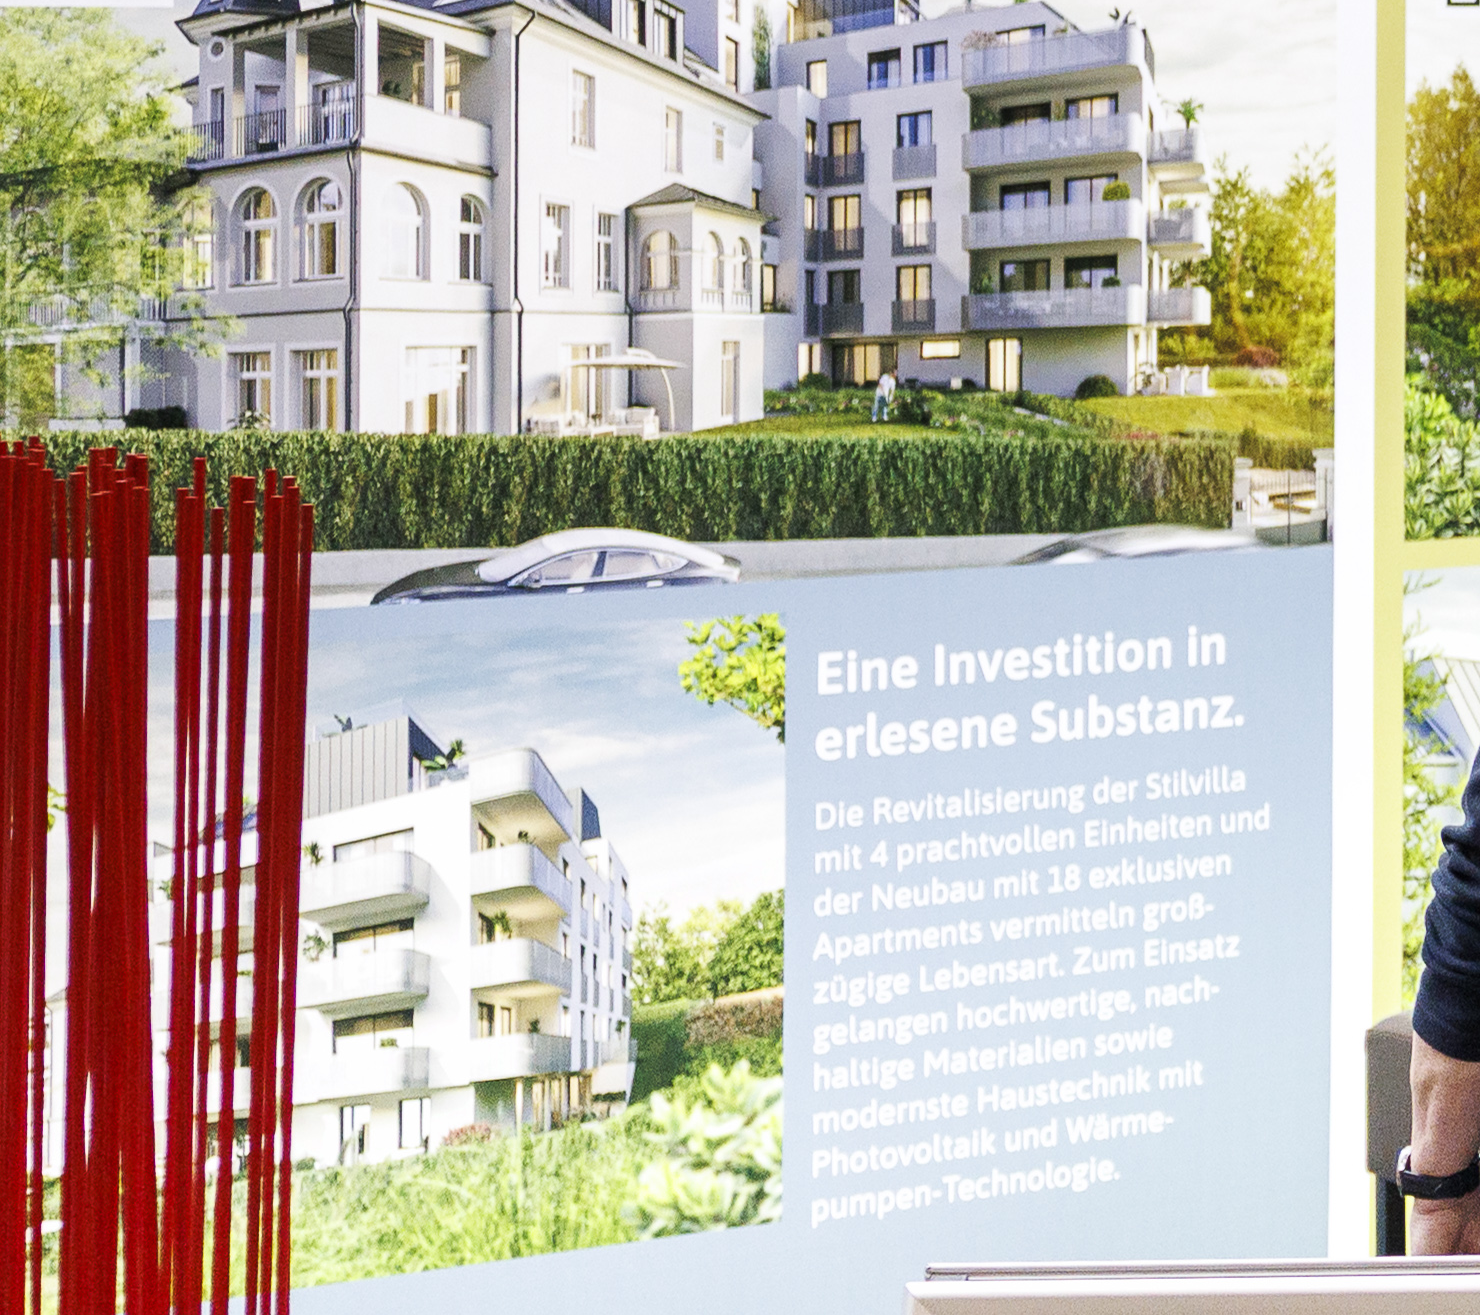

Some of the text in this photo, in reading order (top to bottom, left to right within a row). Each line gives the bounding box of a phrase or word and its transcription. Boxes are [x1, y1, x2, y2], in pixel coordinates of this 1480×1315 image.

[818, 625, 1225, 695] Eine Investition in
[815, 695, 1244, 760] erlesene Substanz.
[815, 765, 1245, 831] Die Revitalisierung der Stilvilla
[815, 802, 1270, 874] mit 4 prachtvollen Einheiten und
[814, 853, 1231, 917] der Neubau mit 18 exklusiven
[812, 892, 1214, 964] Apartments vermitteln groß-
[813, 935, 1240, 1007] zügige Lebensart. Zum Einsatz
[813, 976, 1220, 1055] gelangen hochwertige, nach-
[813, 1023, 1172, 1091] haltige Materialien sowie
[813, 1060, 1204, 1135] modernste Haustechnik mit
[812, 1110, 1174, 1177] Photovoltaik und Wärme-
[811, 1156, 1120, 1228] pumpen-Technologie.
